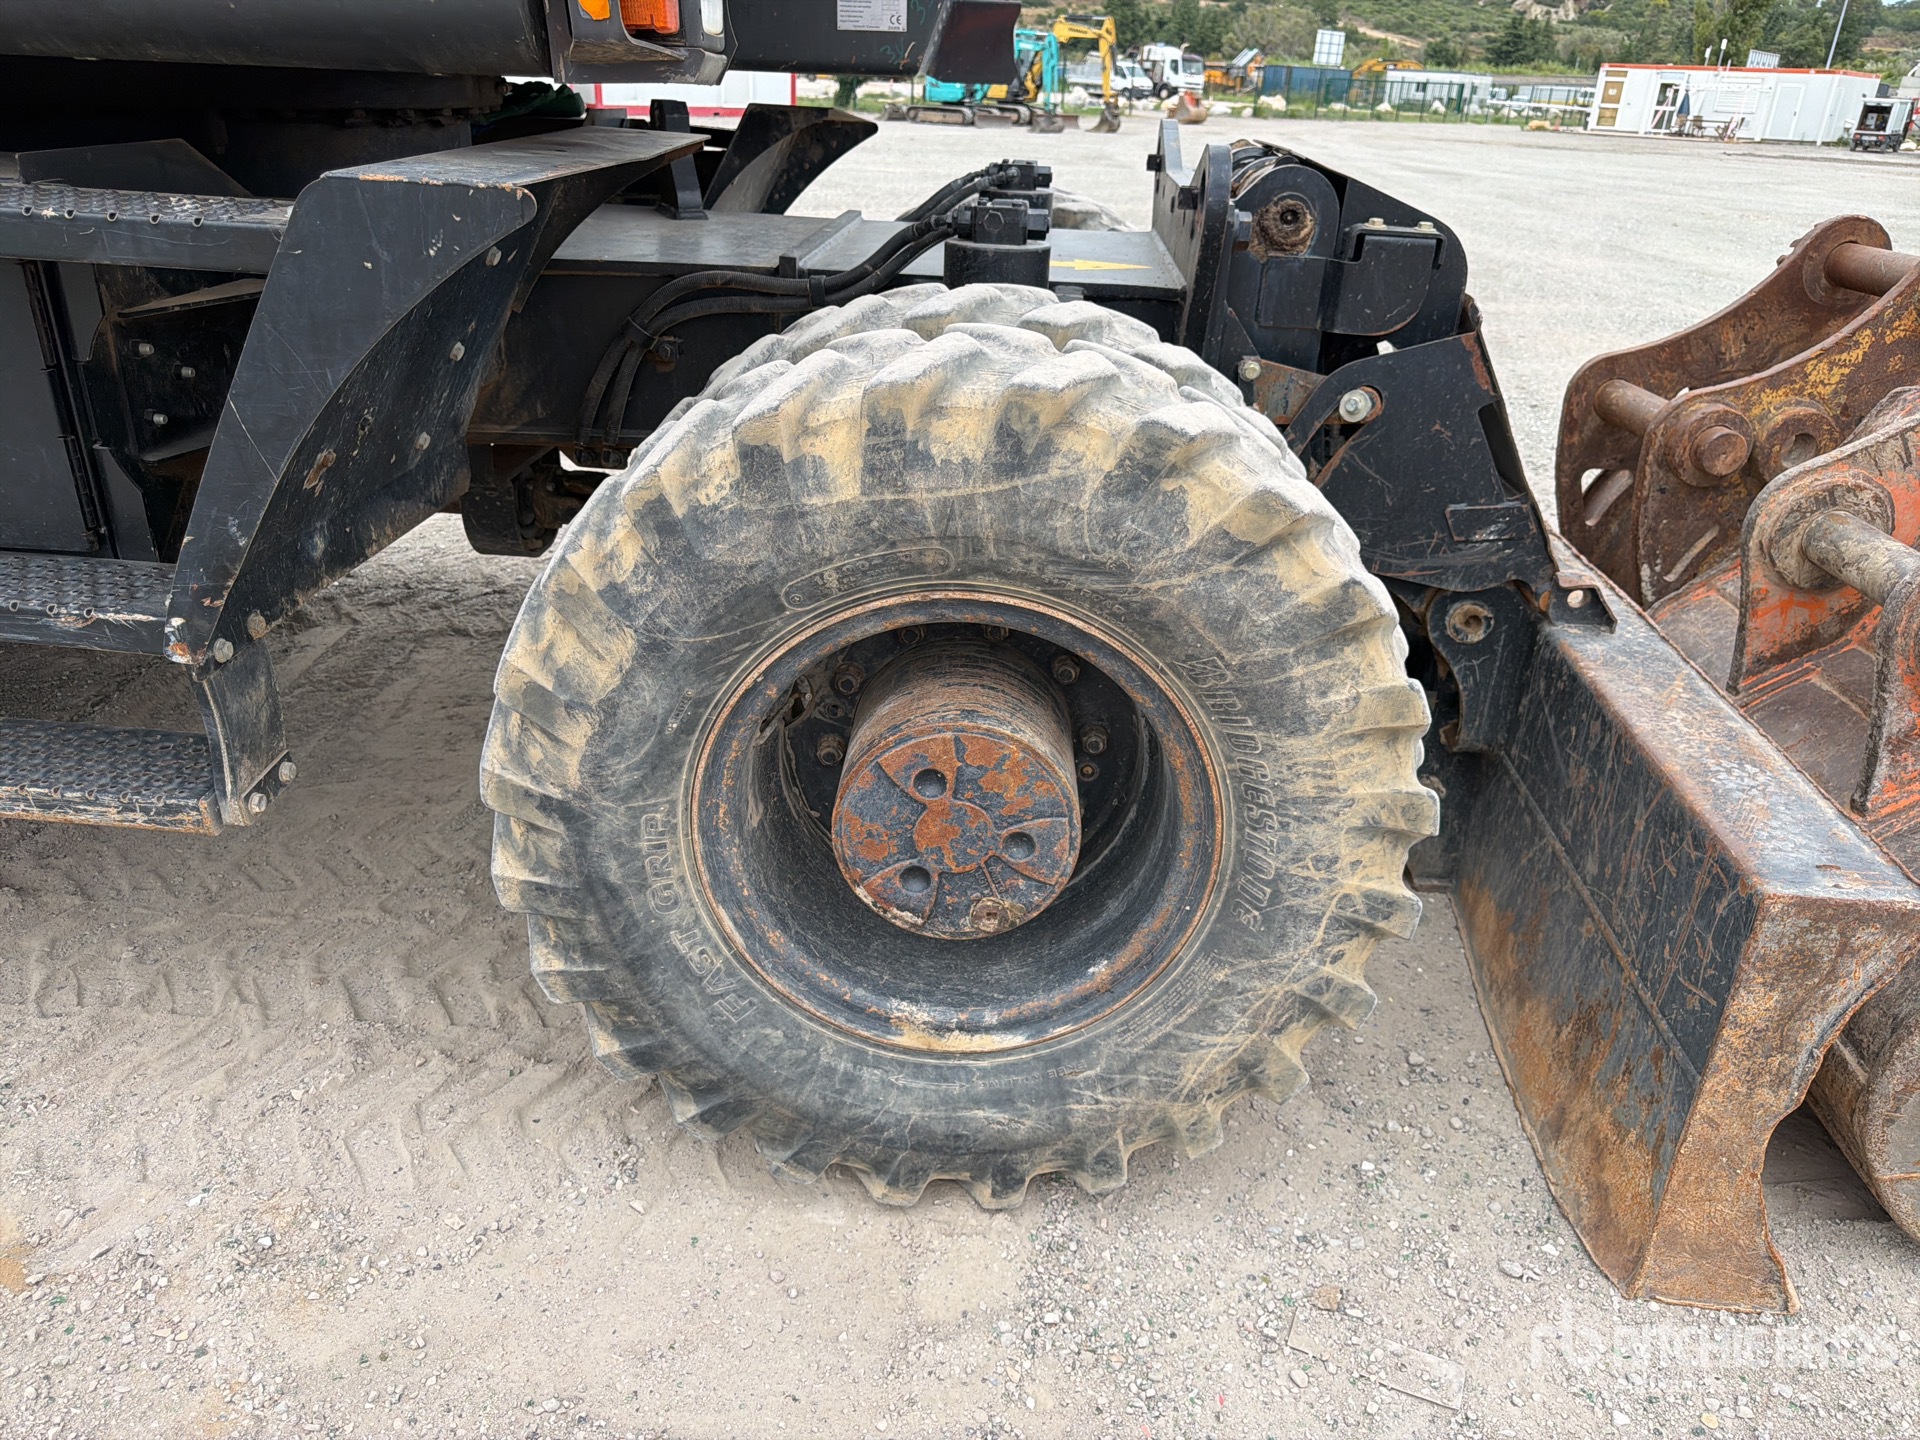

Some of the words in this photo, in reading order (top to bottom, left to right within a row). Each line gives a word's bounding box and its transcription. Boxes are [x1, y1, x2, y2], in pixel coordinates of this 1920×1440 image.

[1173, 655, 1280, 931] BRIDGESTONE
[641, 807, 682, 915] GRIP
[670, 927, 758, 1023] FAST
